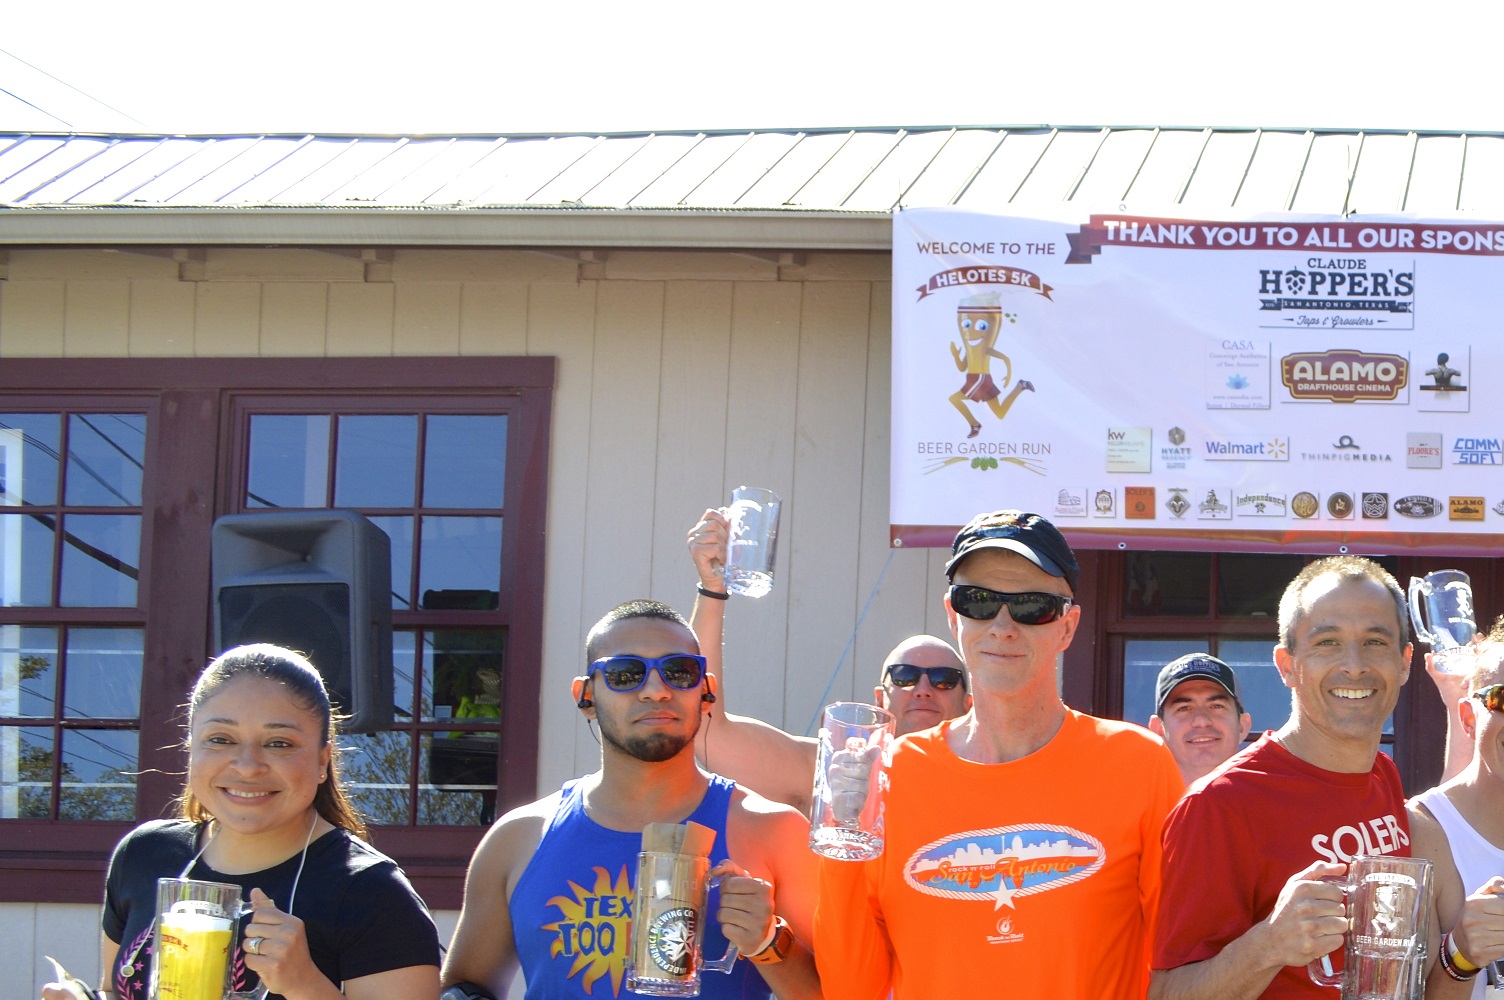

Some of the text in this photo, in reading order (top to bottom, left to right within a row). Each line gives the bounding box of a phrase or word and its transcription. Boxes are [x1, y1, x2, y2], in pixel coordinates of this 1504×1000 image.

[1103, 221, 1195, 244] THANK
[1201, 225, 1260, 246] YOU
[1262, 226, 1299, 247] TO
[1304, 227, 1357, 249] ALL
[1358, 228, 1415, 249] OUR
[917, 241, 1055, 256] WELCOME TO THE
[1307, 258, 1367, 270] CLAUDE
[935, 268, 1032, 287] HELOTES 5K
[1297, 315, 1320, 326] Taps
[1222, 340, 1254, 350] CASA
[1293, 360, 1397, 382] ALAMO
[1297, 383, 1391, 392] DRAFTHOUSE CINEMA
[918, 442, 1051, 455] BEER GARDEN RUN
[1205, 441, 1265, 454] Walmart
[1453, 438, 1501, 450] COMM
[1459, 452, 1496, 465] SOFT
[930, 861, 973, 884] San
[981, 857, 1076, 880] Antonio
[652, 909, 683, 936] BREWING
[558, 921, 616, 956] TOO
[1356, 935, 1372, 944] BEER
[1374, 936, 1403, 946] GARDEN
[649, 933, 688, 975] INDEPENDENCE
